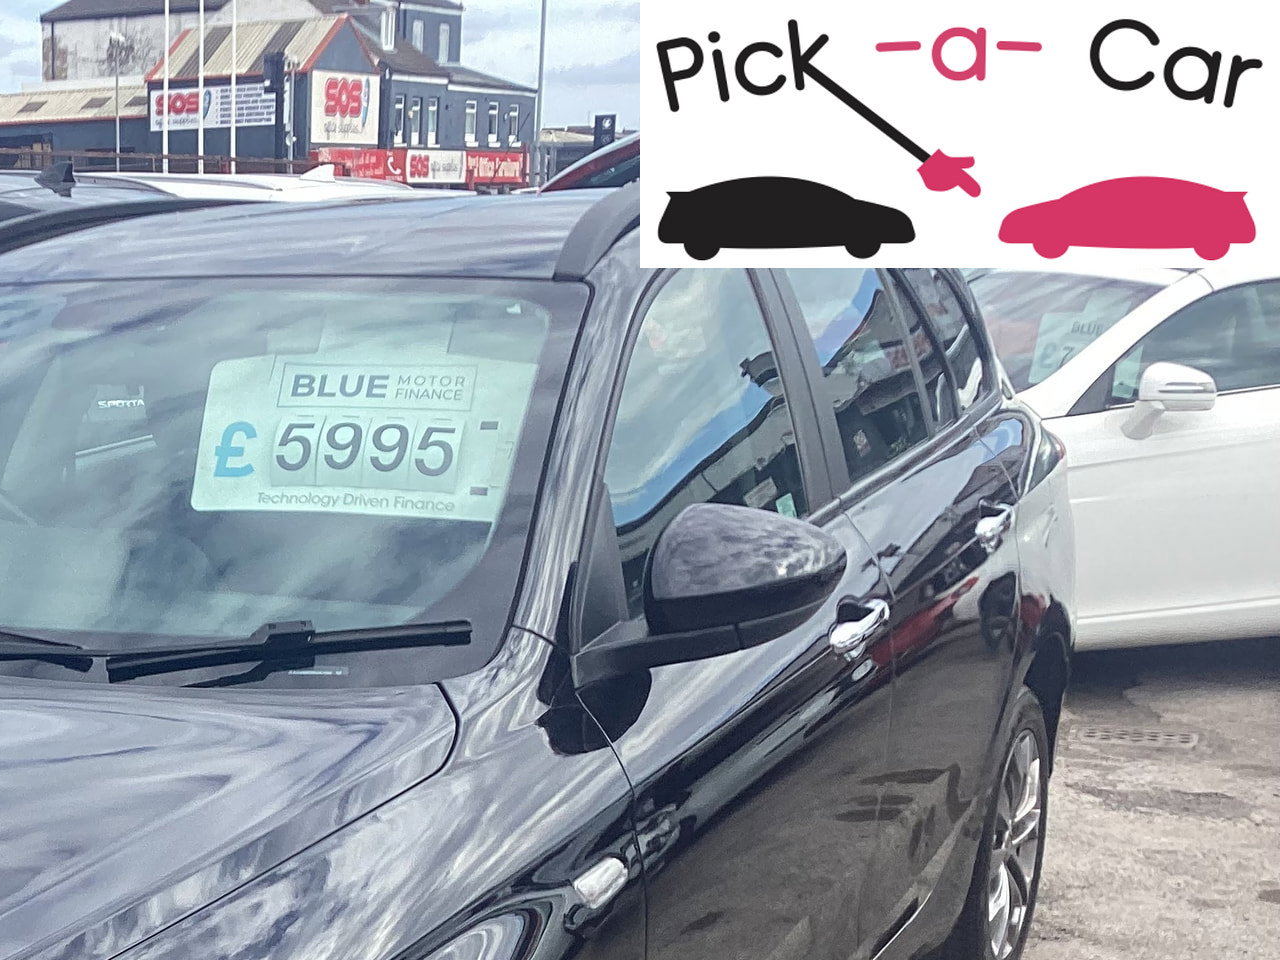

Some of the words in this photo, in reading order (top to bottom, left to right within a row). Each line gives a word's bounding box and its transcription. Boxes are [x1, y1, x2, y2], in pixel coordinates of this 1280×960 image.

[325, 78, 362, 118] SOS
[410, 154, 430, 178] SOS
[290, 374, 390, 399] BLUE
[397, 375, 466, 387] MOTOR
[395, 388, 464, 401] FINANCE
[257, 492, 339, 507] Technology
[343, 493, 389, 508] Driven
[393, 496, 455, 512] Finance
